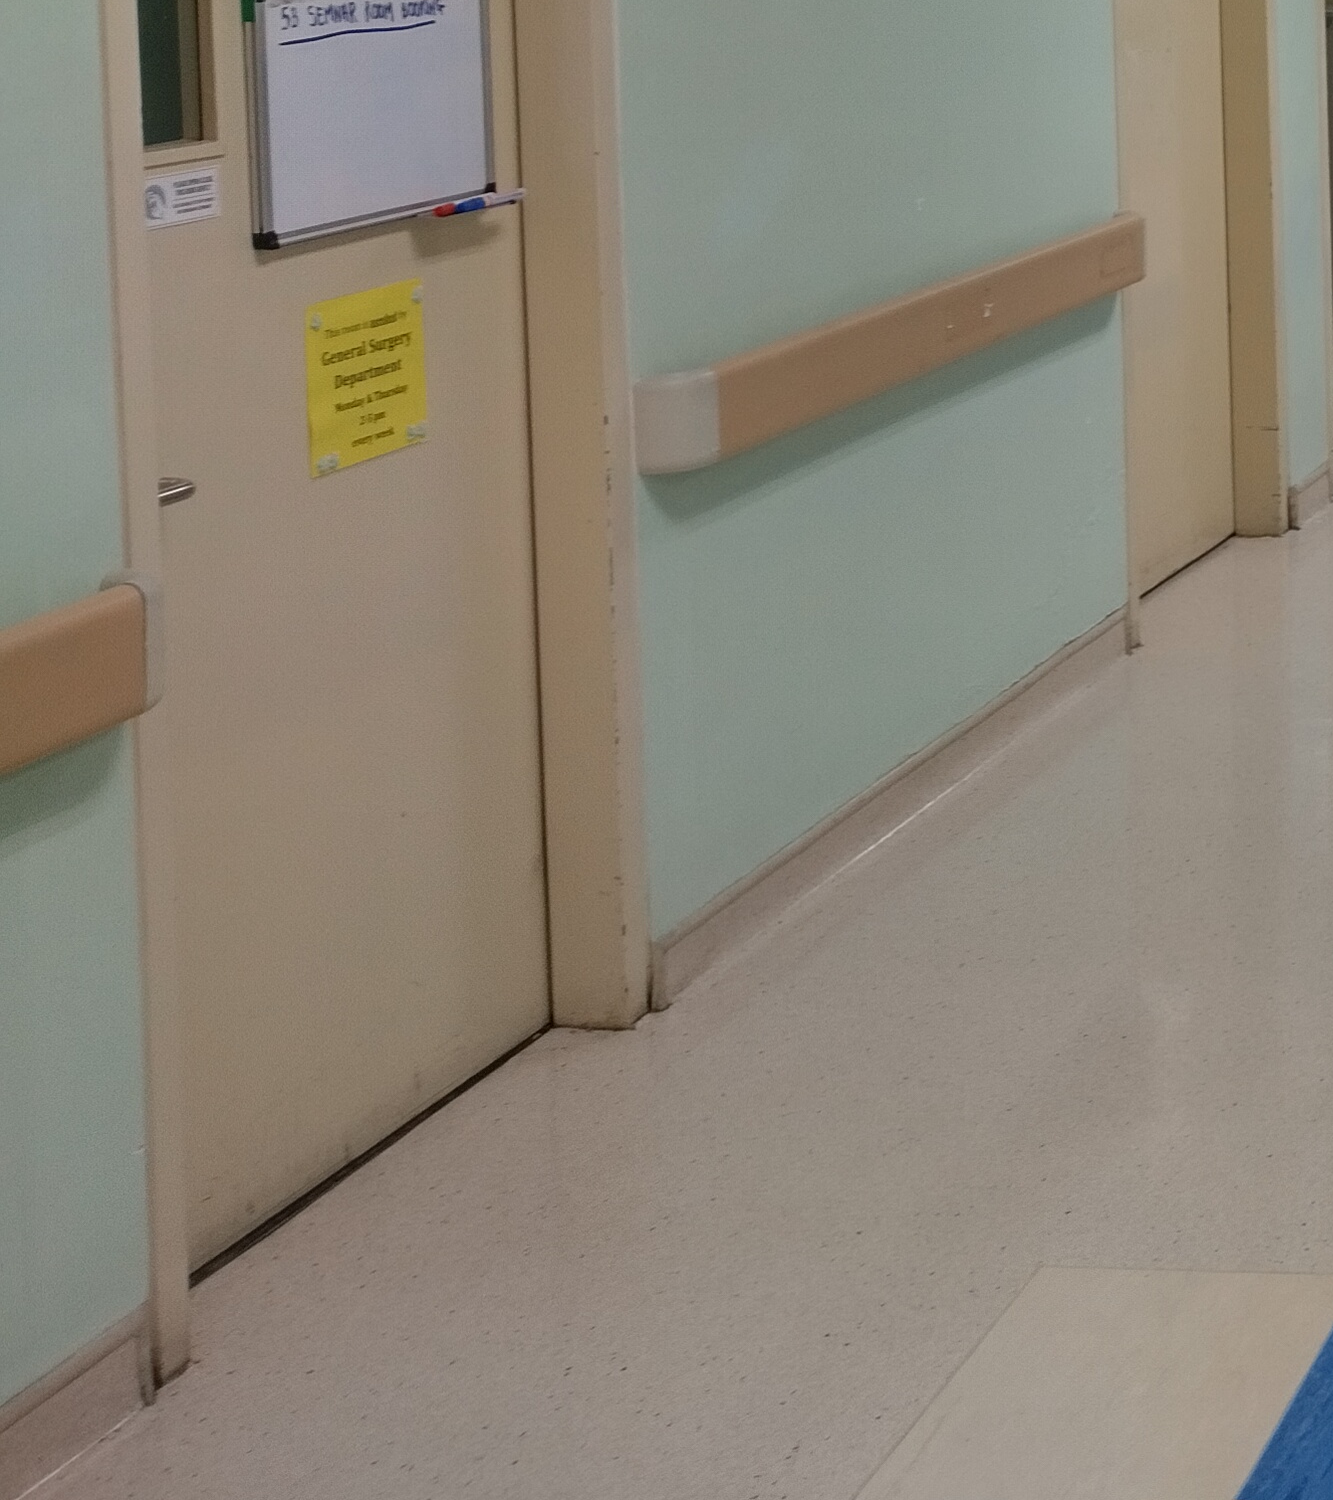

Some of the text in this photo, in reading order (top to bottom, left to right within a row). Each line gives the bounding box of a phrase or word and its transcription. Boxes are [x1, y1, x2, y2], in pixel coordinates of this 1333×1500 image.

[365, 0, 395, 23] ROOM
[321, 331, 413, 367] General Surgery
[334, 359, 403, 390] Department
